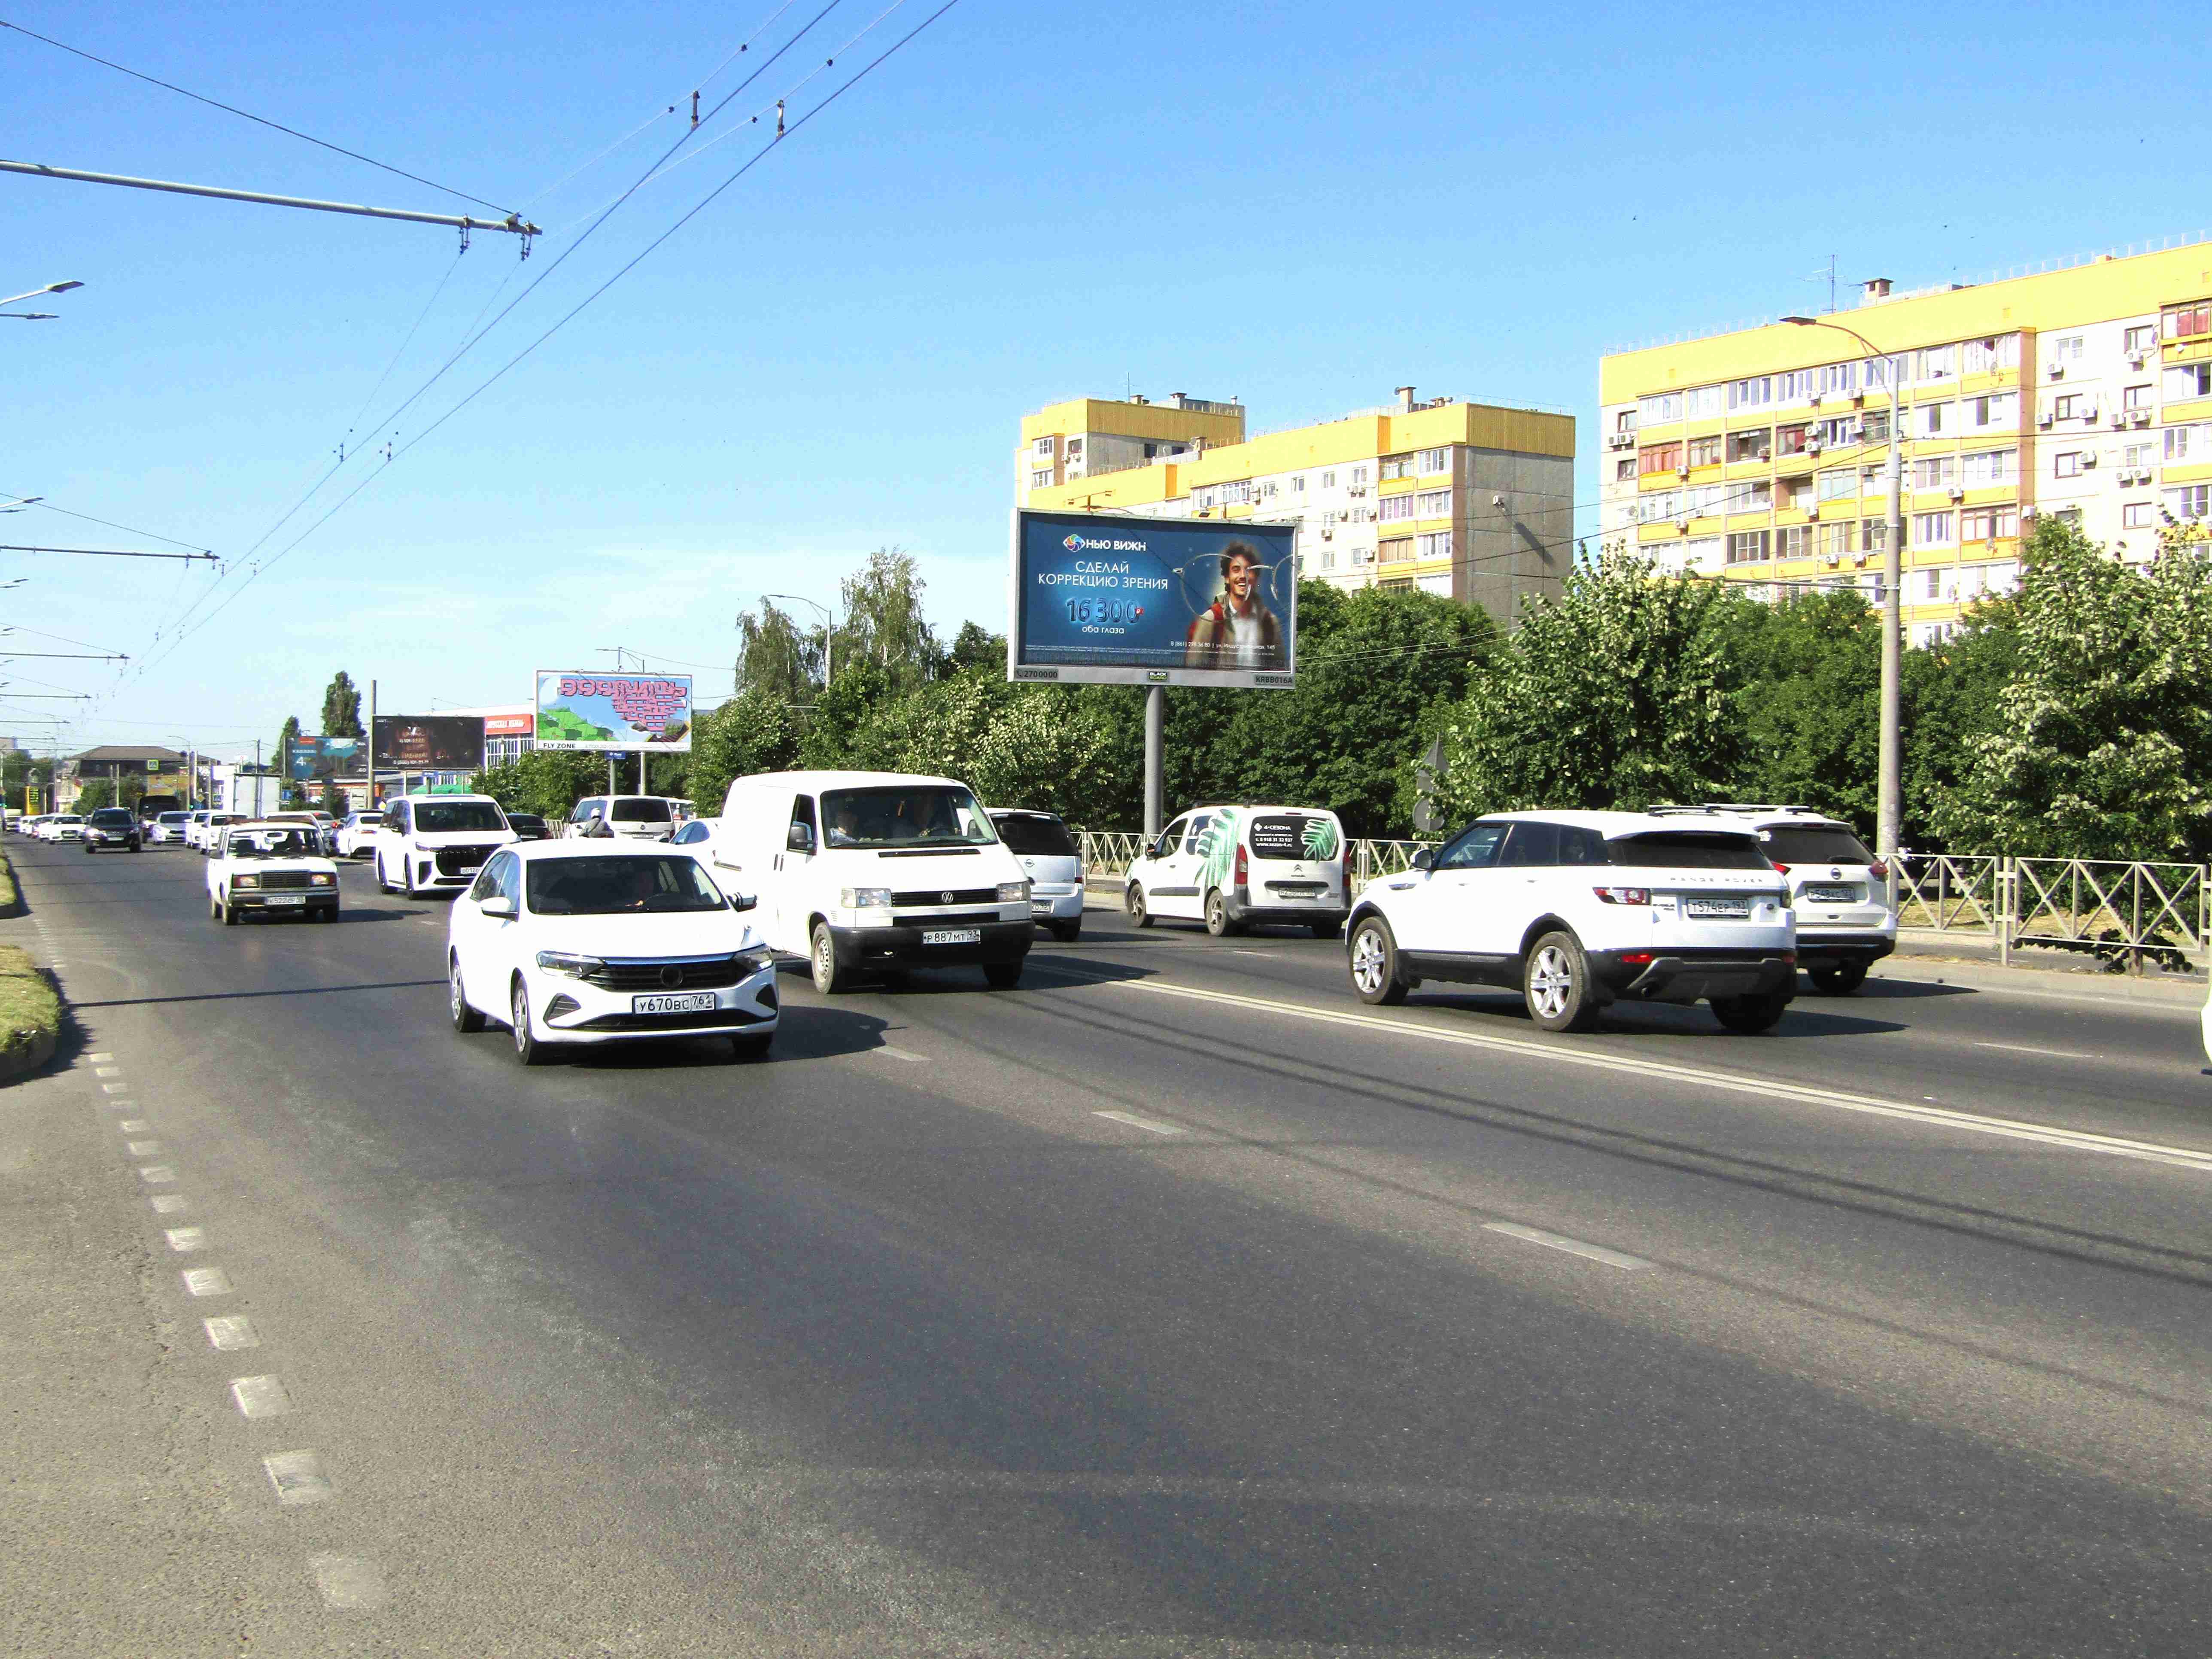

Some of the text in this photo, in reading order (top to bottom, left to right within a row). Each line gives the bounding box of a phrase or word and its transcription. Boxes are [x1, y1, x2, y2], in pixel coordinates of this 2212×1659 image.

[1086, 539, 1146, 551] НЬЮ ВИЖН
[1076, 561, 1129, 574] СДЕЛАЙ
[1038, 573, 1168, 589] КОРРЕКЦИЮ ЗРЕНИЯ
[1082, 625, 1099, 633] оба
[927, 932, 966, 942] Р887МТ
[640, 998, 689, 1012] У670ВС
